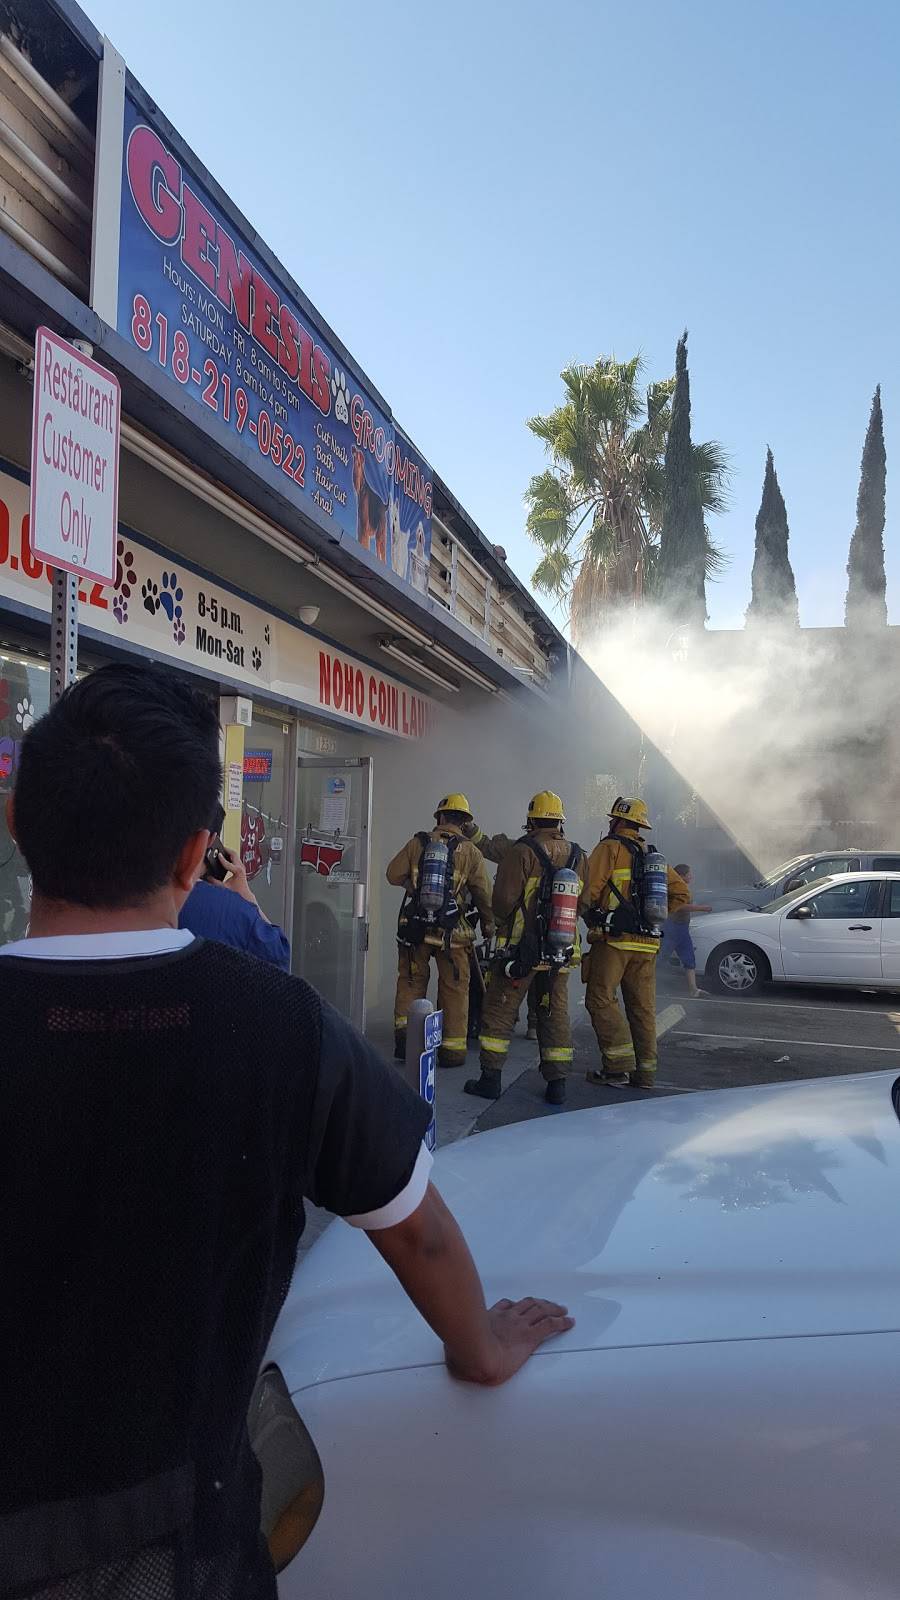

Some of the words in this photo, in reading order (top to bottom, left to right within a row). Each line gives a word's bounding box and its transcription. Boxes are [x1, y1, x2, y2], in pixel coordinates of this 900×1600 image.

[127, 124, 332, 417] GENESIS
[163, 256, 196, 304] Hours:
[198, 293, 226, 335] MON.
[233, 328, 247, 357] FRI.
[251, 348, 257, 365] 8
[257, 359, 271, 382] am
[272, 371, 280, 390] to
[281, 381, 287, 397] 5
[287, 390, 300, 412] pm
[181, 304, 232, 366] SATURDAY
[235, 358, 242, 376] 8
[243, 369, 258, 393] am
[258, 381, 267, 401] to
[268, 393, 274, 408] 4
[274, 401, 288, 422] pm
[43, 341, 114, 434] Restaurant
[131, 294, 306, 488] 818-219-0522
[42, 412, 107, 493] Customer
[316, 423, 331, 447] Cut
[330, 435, 349, 466] Nails
[316, 444, 335, 473] Bath
[350, 394, 433, 519] GROOMING
[315, 466, 333, 492] Hair
[333, 484, 347, 505] Cut
[60, 490, 92, 565] Only
[195, 625, 245, 668] Mon-Sat
[198, 591, 218, 623] 8-5
[221, 606, 244, 635] p.m.
[318, 651, 365, 718] NOHO
[368, 675, 399, 732] COIN
